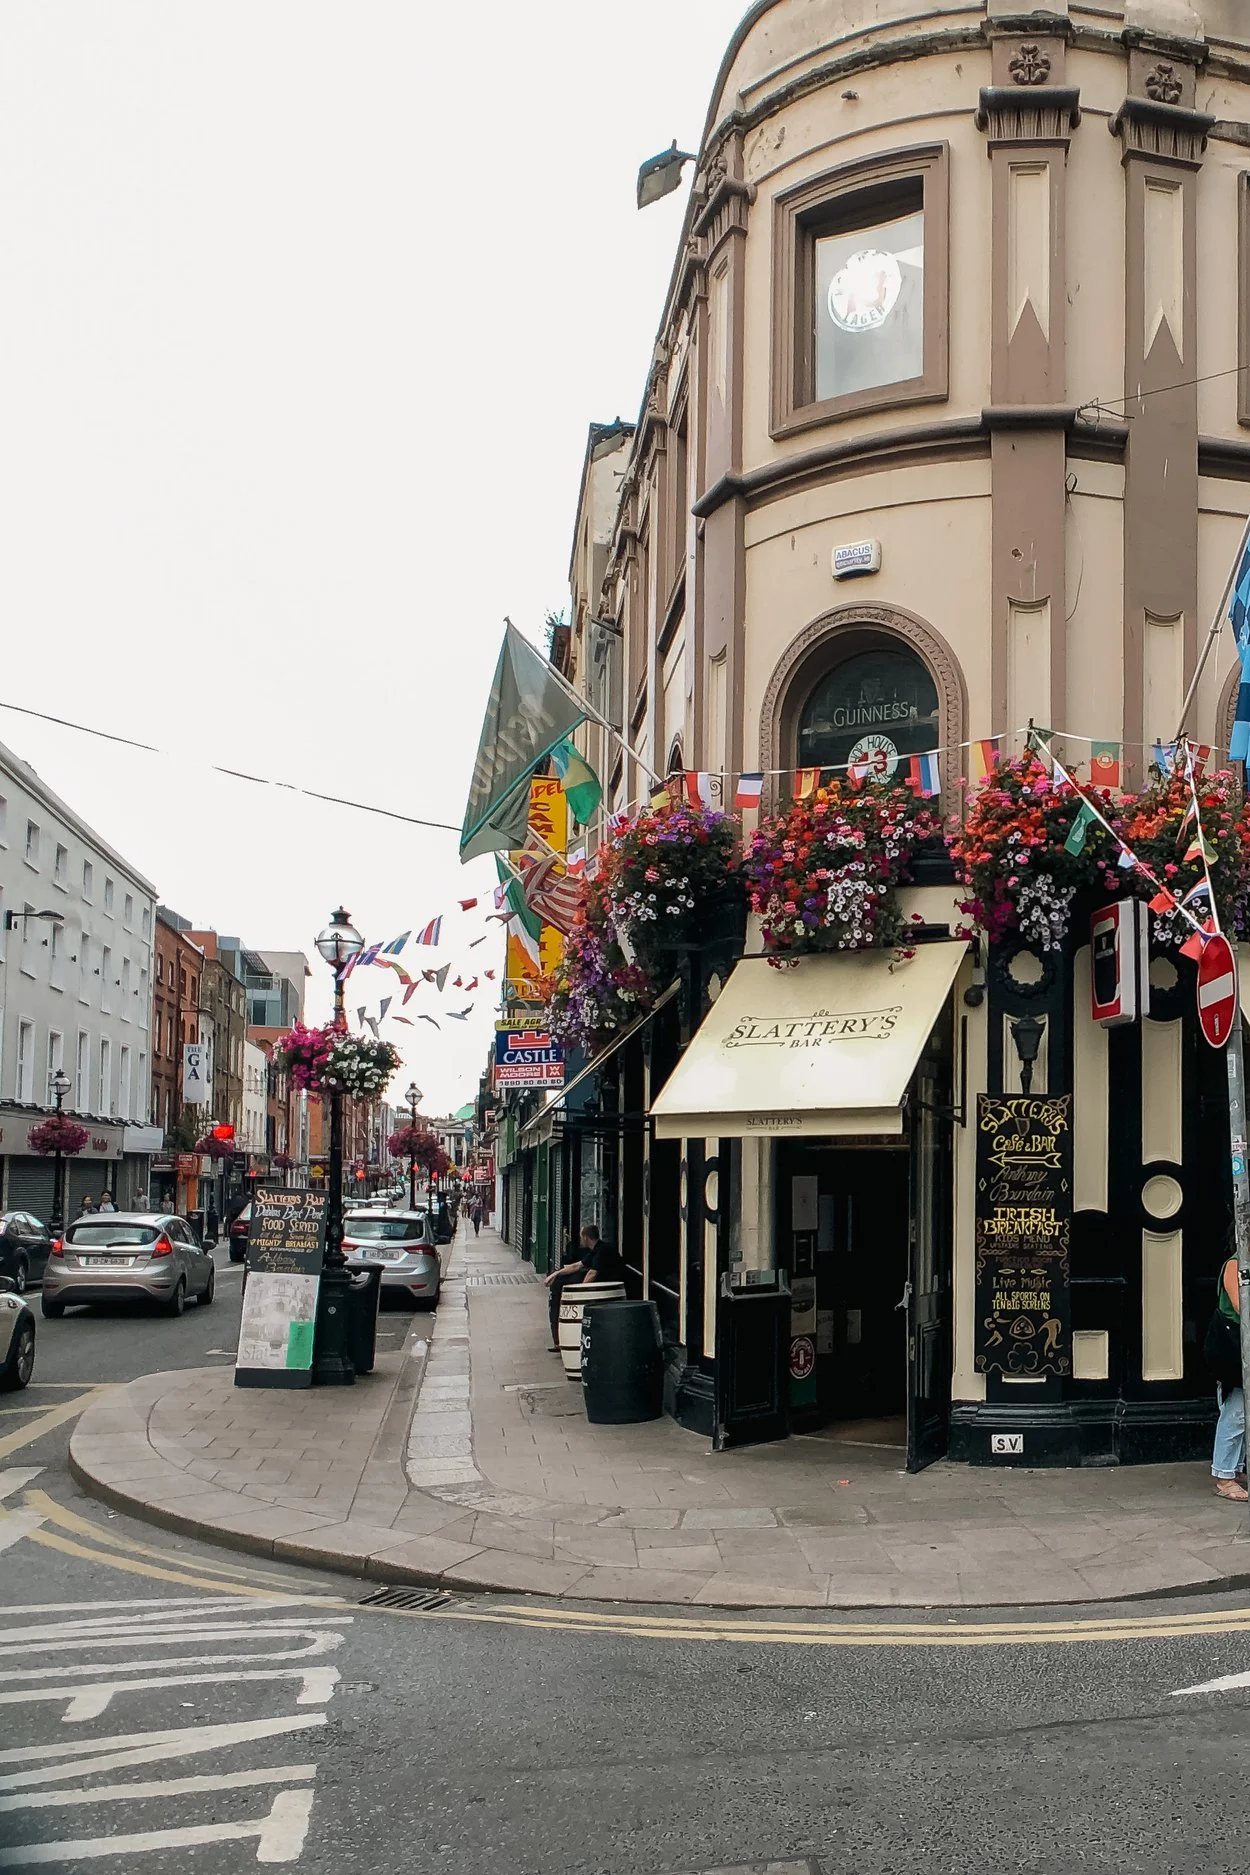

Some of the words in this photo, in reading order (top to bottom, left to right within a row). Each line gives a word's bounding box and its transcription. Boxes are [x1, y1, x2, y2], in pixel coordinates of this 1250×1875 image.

[836, 545, 870, 559] ABACUS
[833, 701, 909, 727] GUINNESS
[731, 1015, 898, 1040] SLATTERY'S
[789, 1038, 822, 1049] BAR
[503, 1049, 557, 1064] CASTLE
[746, 1116, 803, 1126] SLATTERY'S
[1031, 1135, 1056, 1152] BAR
[993, 1207, 1056, 1222] IRISH
[262, 1217, 285, 1231] FOOD
[289, 1219, 319, 1233] SERVED
[983, 1219, 1063, 1236] BREAKFAST
[995, 1234, 1020, 1243] KIDS
[1023, 1234, 1051, 1243] MENU
[992, 1276, 1017, 1289] Live
[1021, 1277, 1052, 1290] Music
[995, 1291, 1009, 1301] ALL
[1011, 1291, 1038, 1301] SPORTS
[1039, 1291, 1051, 1301] ON
[992, 1300, 1006, 1310] TEN
[1006, 1300, 1021, 1310] BIG
[1021, 1300, 1051, 1311] SCREENS
